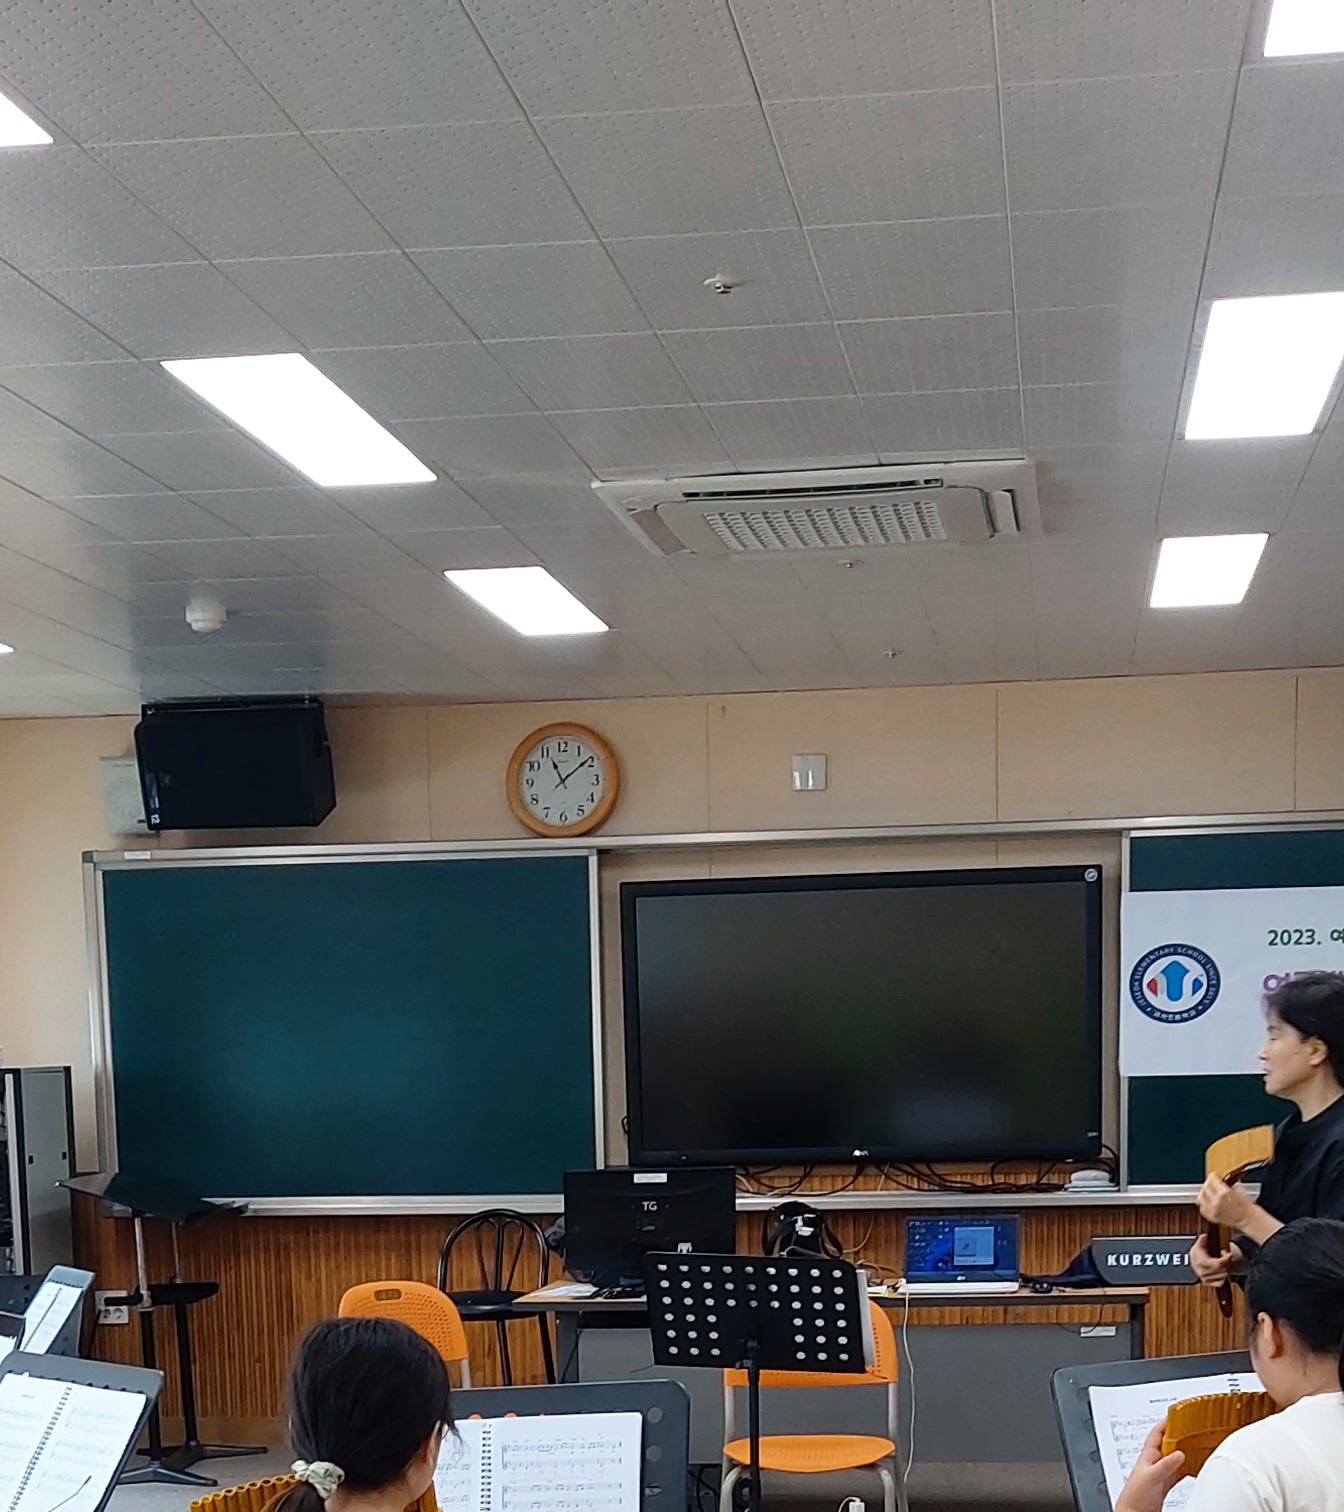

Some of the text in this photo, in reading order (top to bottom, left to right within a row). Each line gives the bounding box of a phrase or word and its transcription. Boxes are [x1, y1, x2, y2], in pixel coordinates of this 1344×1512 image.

[541, 746, 549, 759] 11
[557, 741, 569, 753] 12
[576, 745, 581, 757] 1
[526, 759, 541, 772] 10
[587, 755, 595, 768] 2
[525, 778, 535, 789] 9
[591, 774, 600, 786] 3
[530, 793, 539, 806] 8
[586, 792, 595, 803] 4
[542, 806, 551, 819] 7
[559, 810, 568, 824] 6
[576, 804, 585, 818] 5
[1267, 928, 1322, 946] 2023.
[641, 1201, 658, 1211] TG
[1107, 1253, 1189, 1266] KURZWEI
